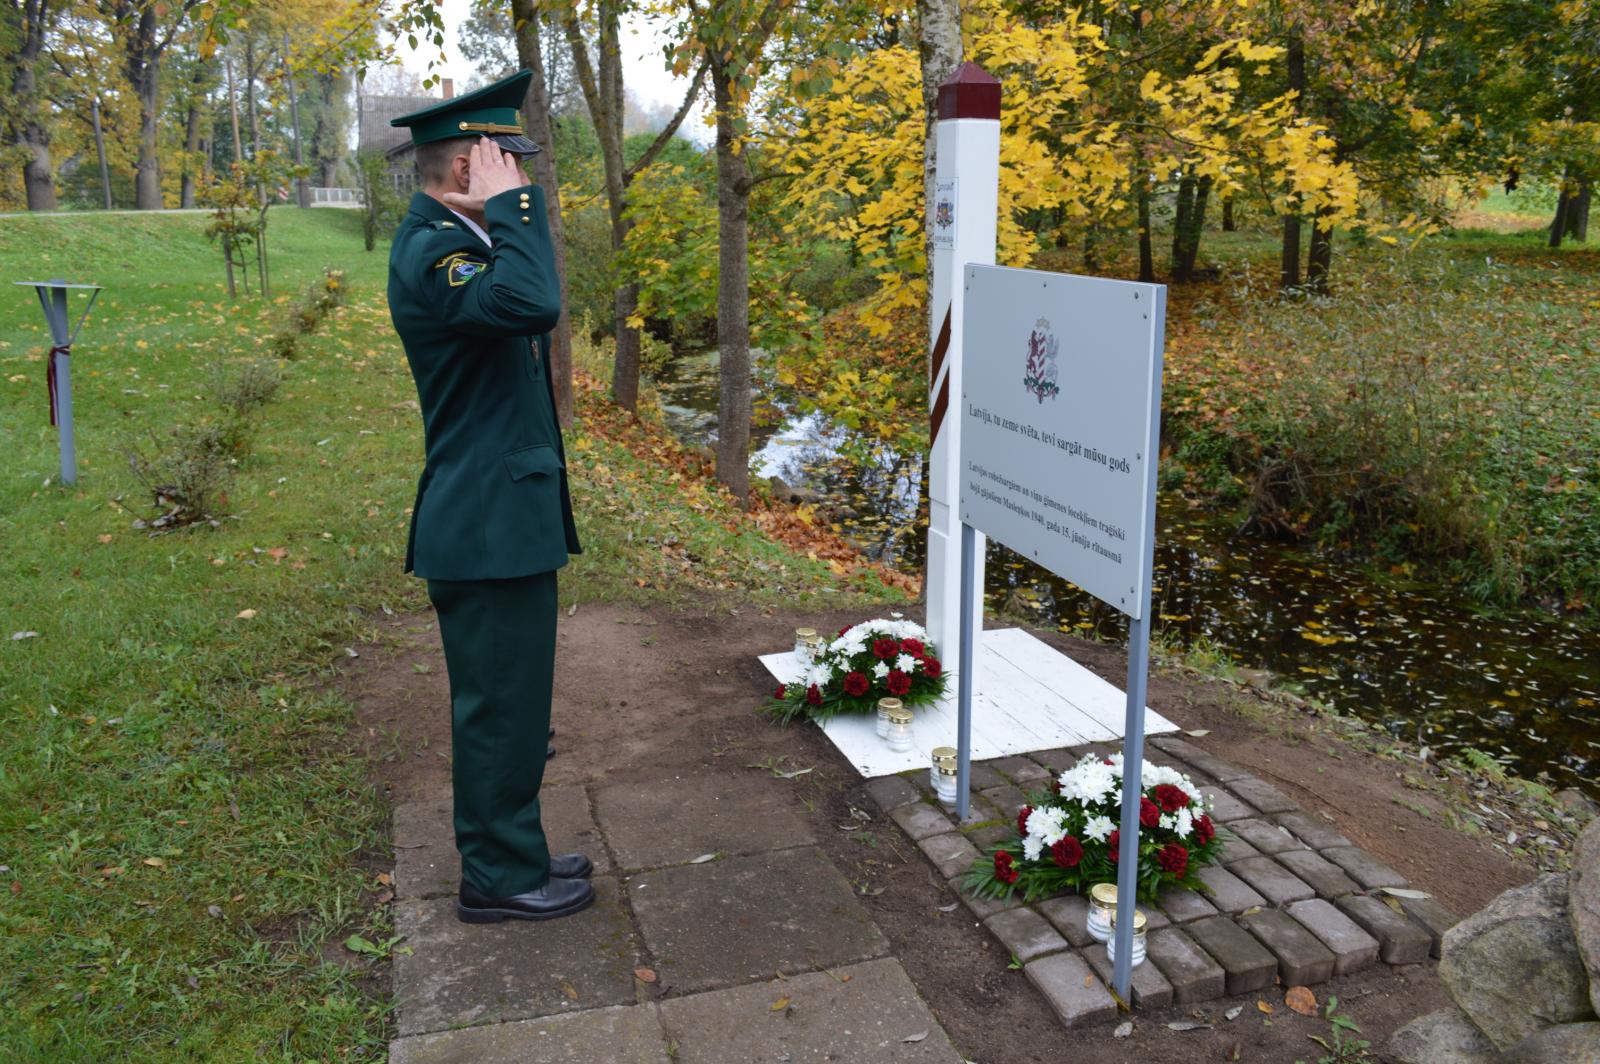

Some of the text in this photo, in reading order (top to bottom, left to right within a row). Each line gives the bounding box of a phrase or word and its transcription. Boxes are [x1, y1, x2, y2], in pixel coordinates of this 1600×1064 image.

[969, 403, 993, 424] Latvija,
[993, 414, 1001, 426] tu
[1002, 418, 1019, 433] zeme
[1041, 431, 1055, 447] tevi
[1057, 438, 1082, 456] sargāt
[1083, 447, 1107, 465] mūsu
[1109, 457, 1131, 474] gods
[1022, 487, 1029, 497] un
[1043, 495, 1067, 514] ģimenes
[1067, 505, 1098, 528] locekļiem
[1099, 520, 1125, 541] traģiski
[1046, 520, 1061, 534] gada
[1062, 525, 1071, 539] 15.
[1071, 529, 1091, 550] jūnija
[1091, 541, 1122, 565] rītausmā
